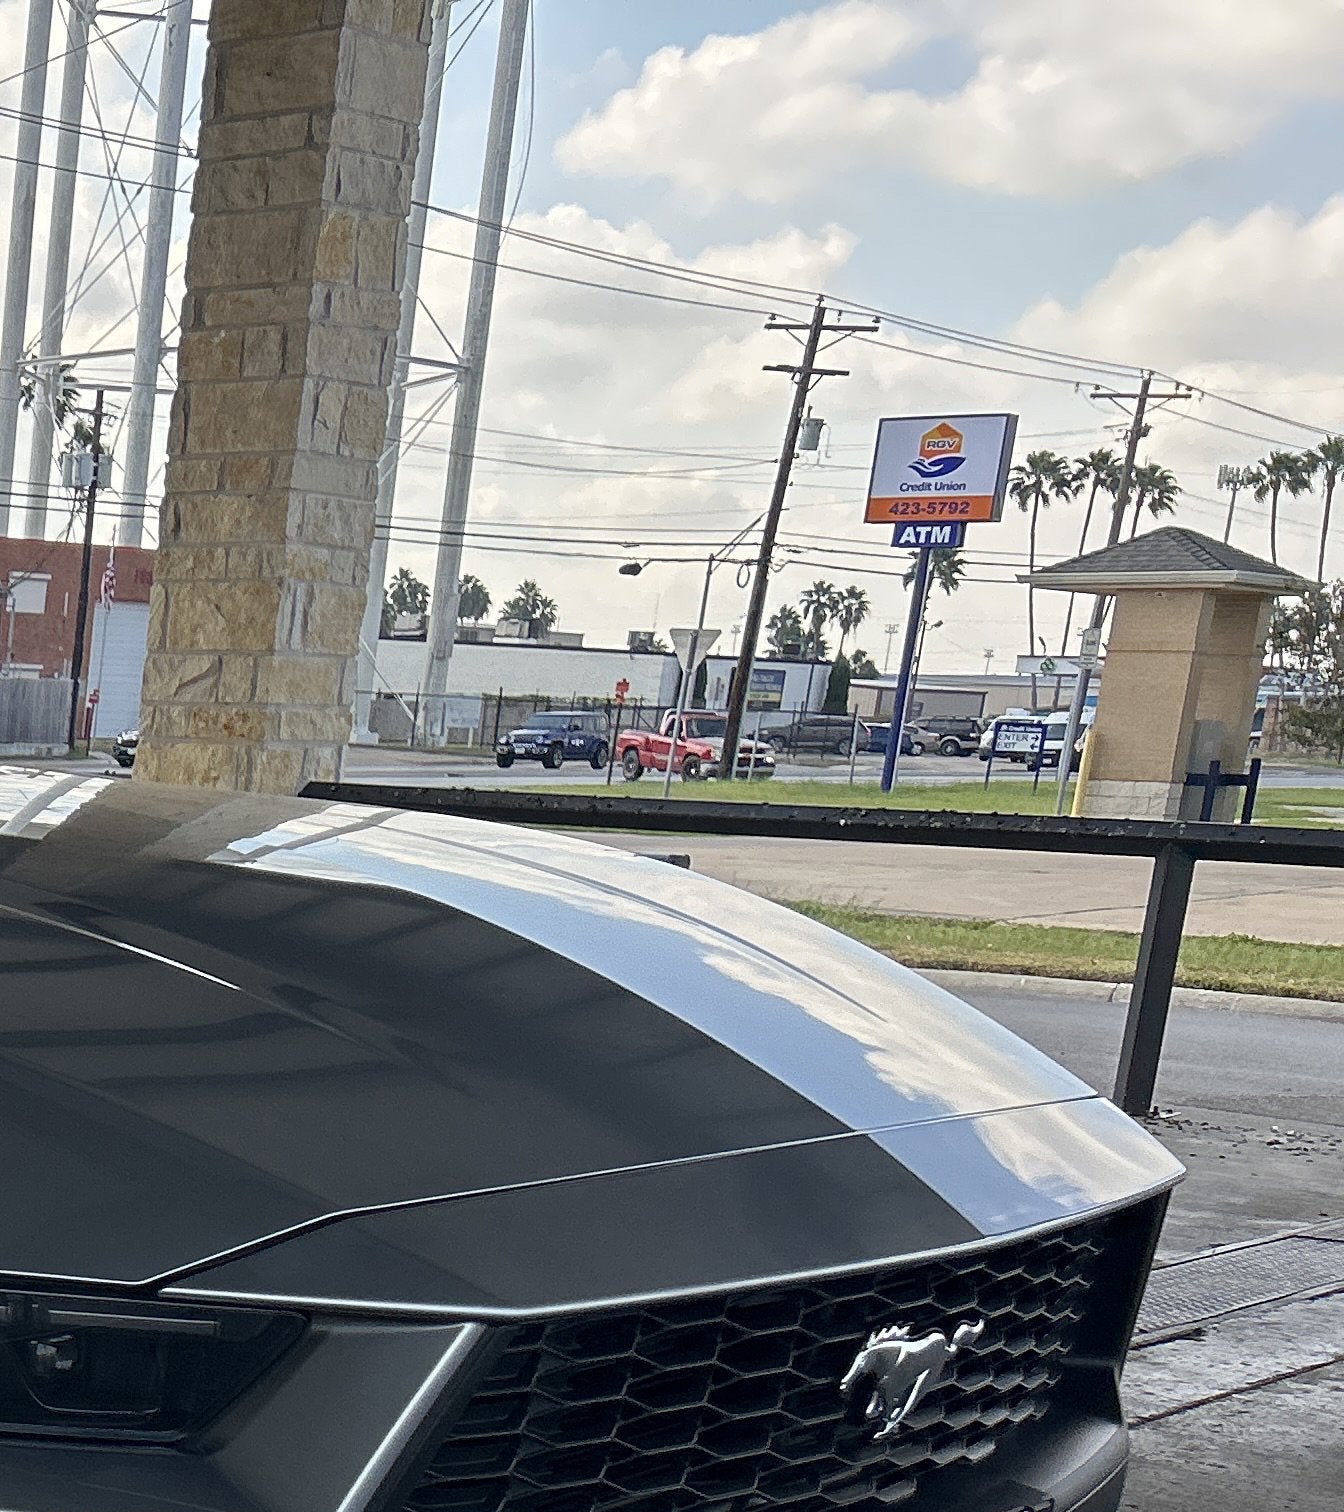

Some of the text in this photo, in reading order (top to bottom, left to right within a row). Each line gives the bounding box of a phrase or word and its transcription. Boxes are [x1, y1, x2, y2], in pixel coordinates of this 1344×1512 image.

[926, 439, 957, 449] RGV
[899, 481, 966, 492] Credit Union
[889, 500, 970, 515] 423-5792
[899, 525, 952, 544] ATM
[997, 733, 1029, 742] ENTER
